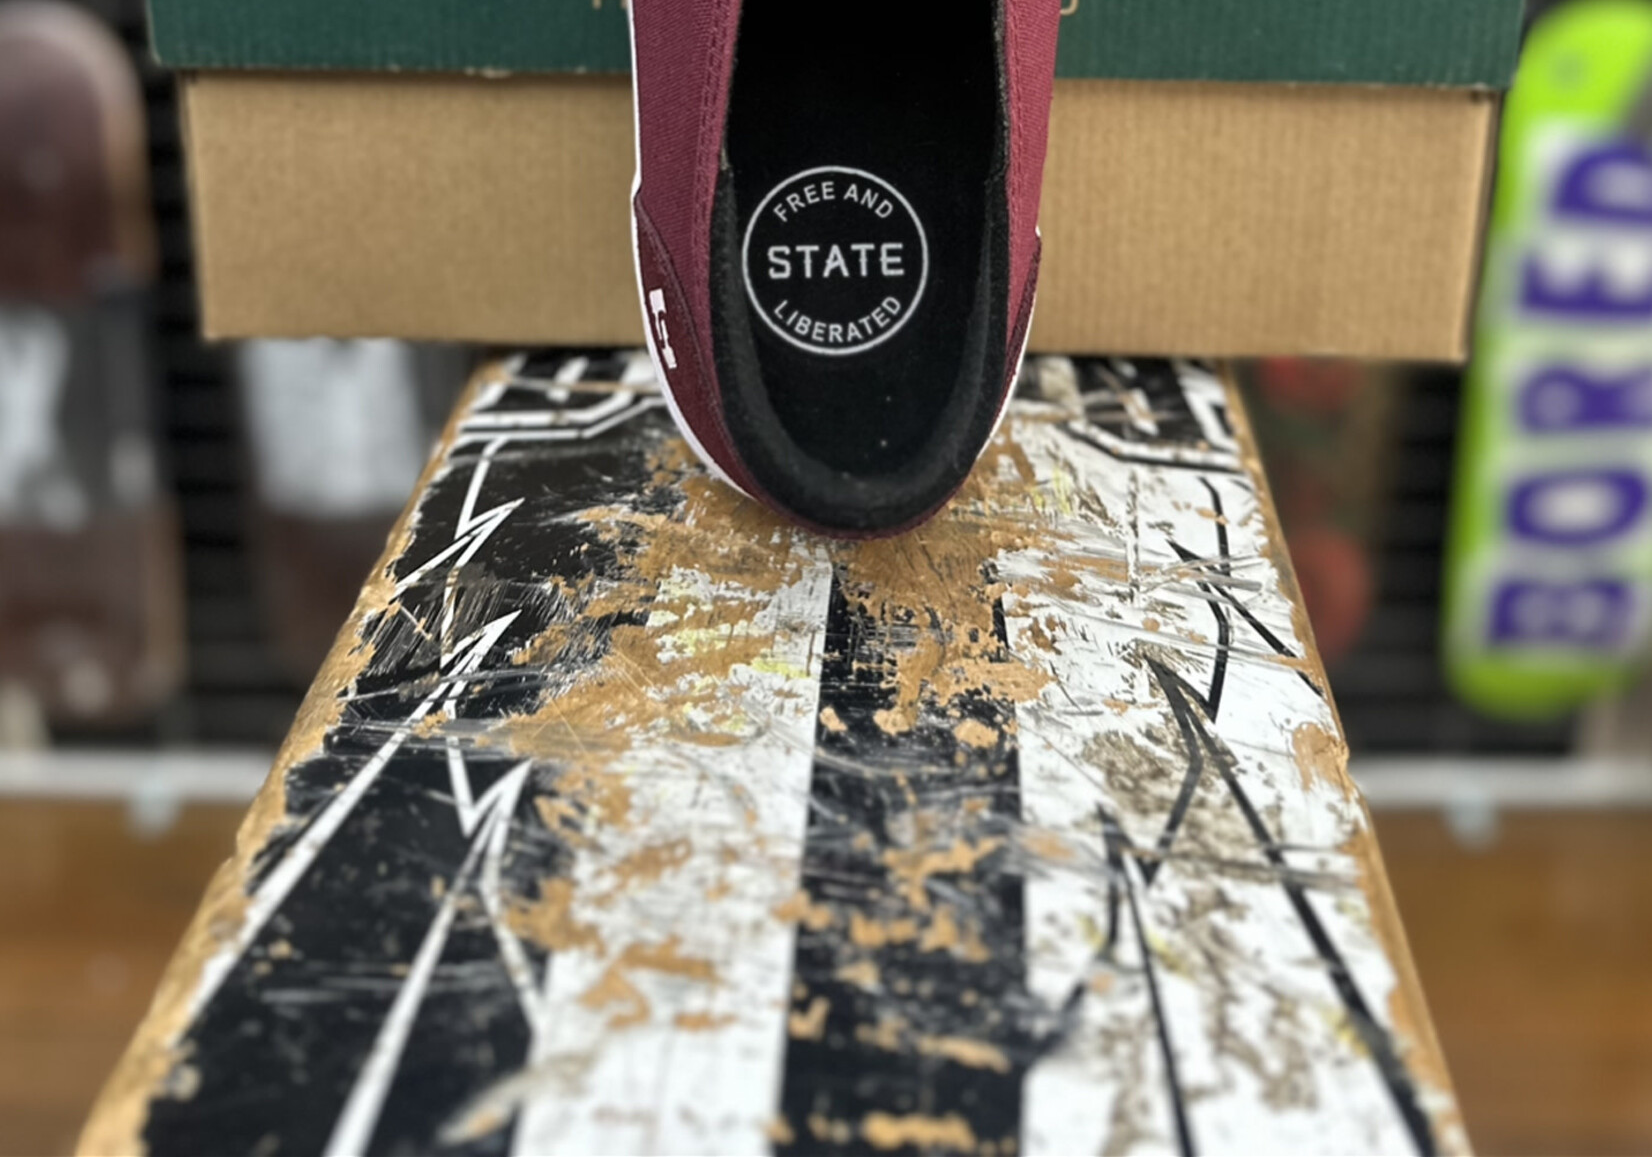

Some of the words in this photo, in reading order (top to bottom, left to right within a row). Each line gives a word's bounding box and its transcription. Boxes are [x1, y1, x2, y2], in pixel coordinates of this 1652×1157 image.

[773, 181, 835, 222] FREE
[843, 183, 894, 219] AND
[767, 242, 905, 280] STATE
[773, 296, 901, 344] LIBERATED
[1488, 128, 1652, 652] BORED
